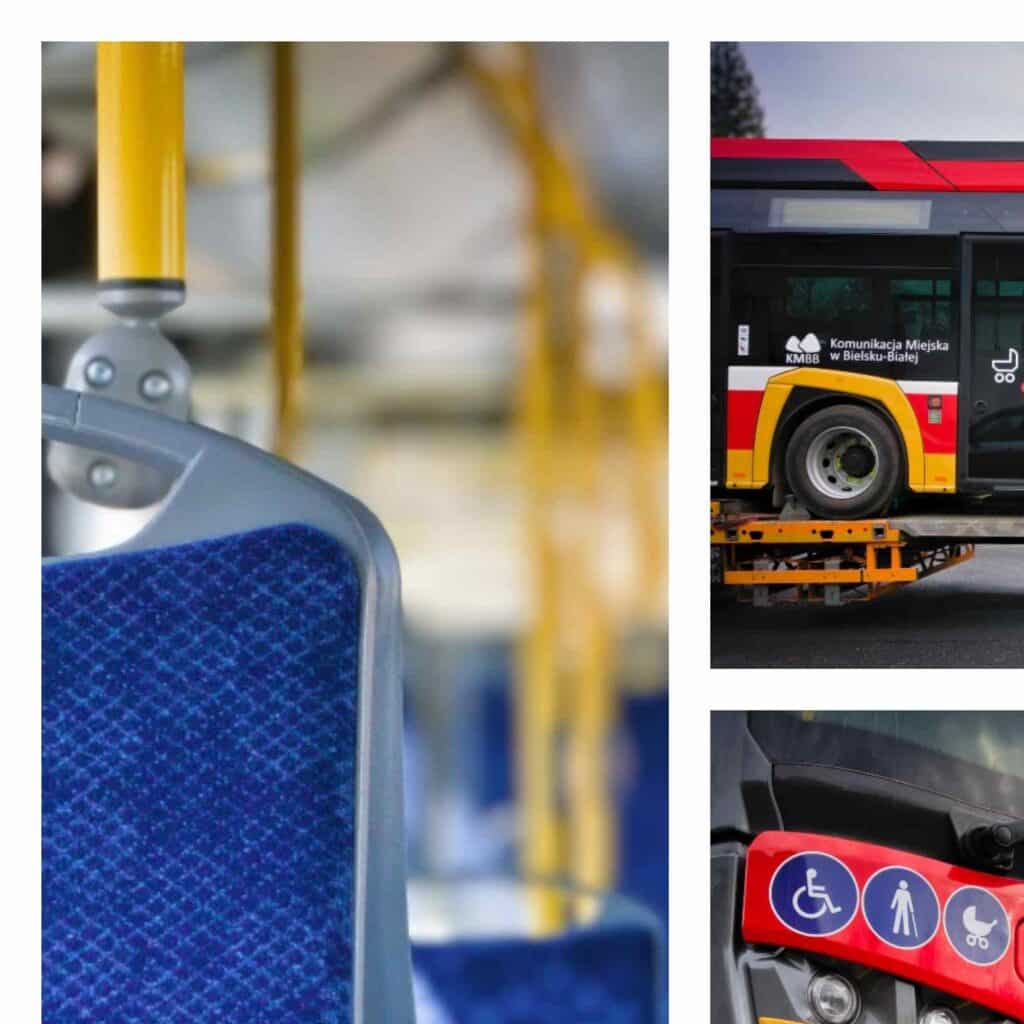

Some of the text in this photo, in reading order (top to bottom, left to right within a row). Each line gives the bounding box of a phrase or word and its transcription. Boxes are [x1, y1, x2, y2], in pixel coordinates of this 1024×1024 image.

[830, 338, 949, 353] Komunikacja Miejska
[785, 353, 820, 364] KMBB
[830, 351, 919, 365] w Bielsku-Białej
